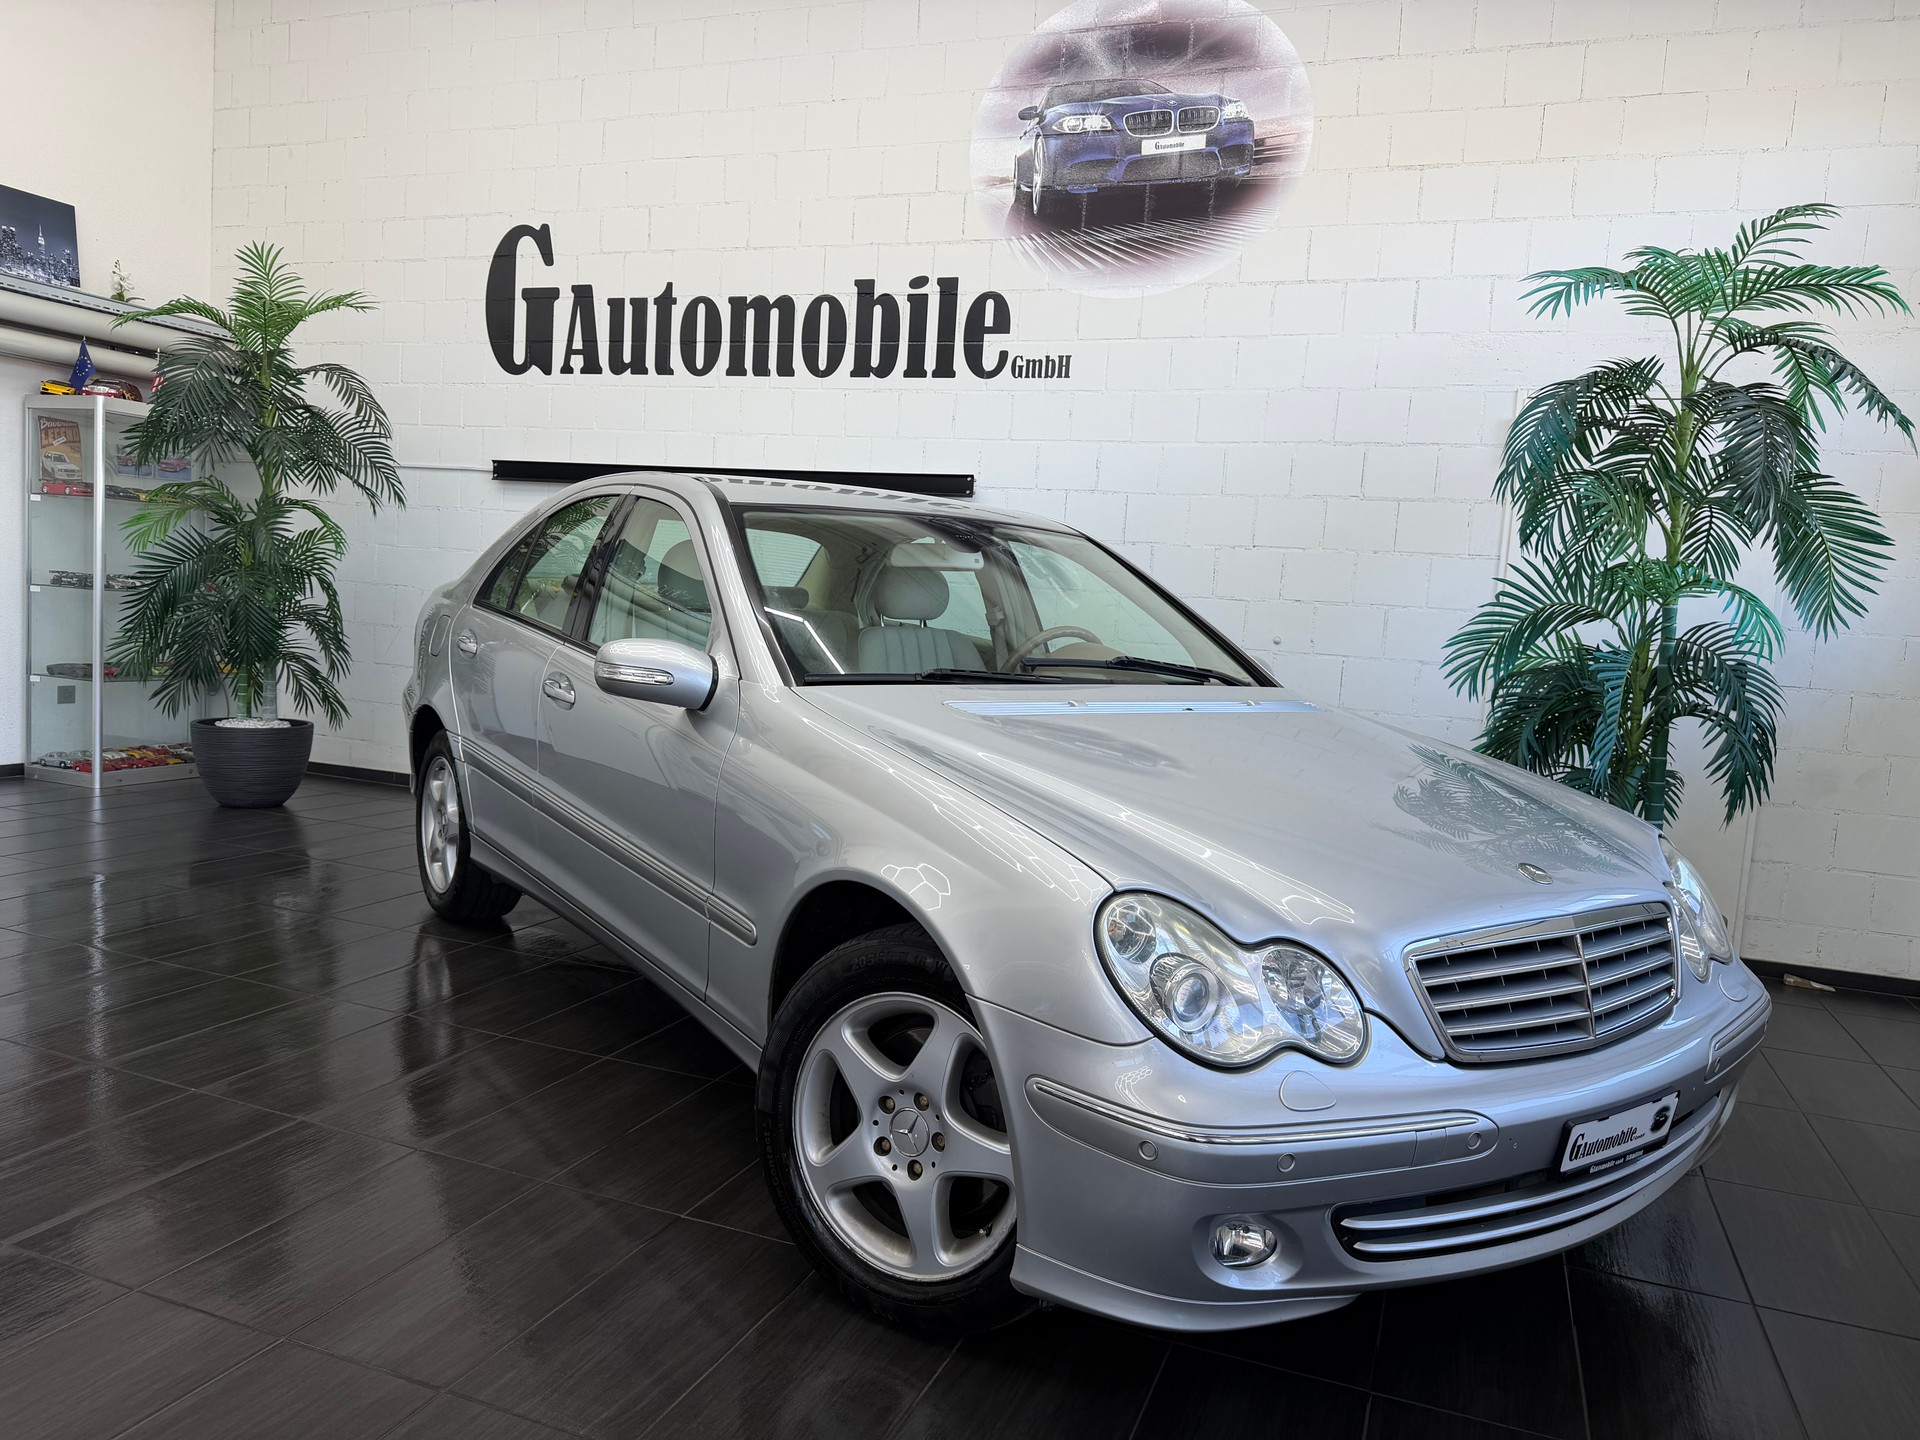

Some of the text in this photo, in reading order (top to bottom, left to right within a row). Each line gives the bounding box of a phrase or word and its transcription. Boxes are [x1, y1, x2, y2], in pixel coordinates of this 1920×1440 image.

[485, 222, 1073, 379] GAutomobile GmbH
[1570, 1126, 1638, 1161] GAutomobile
